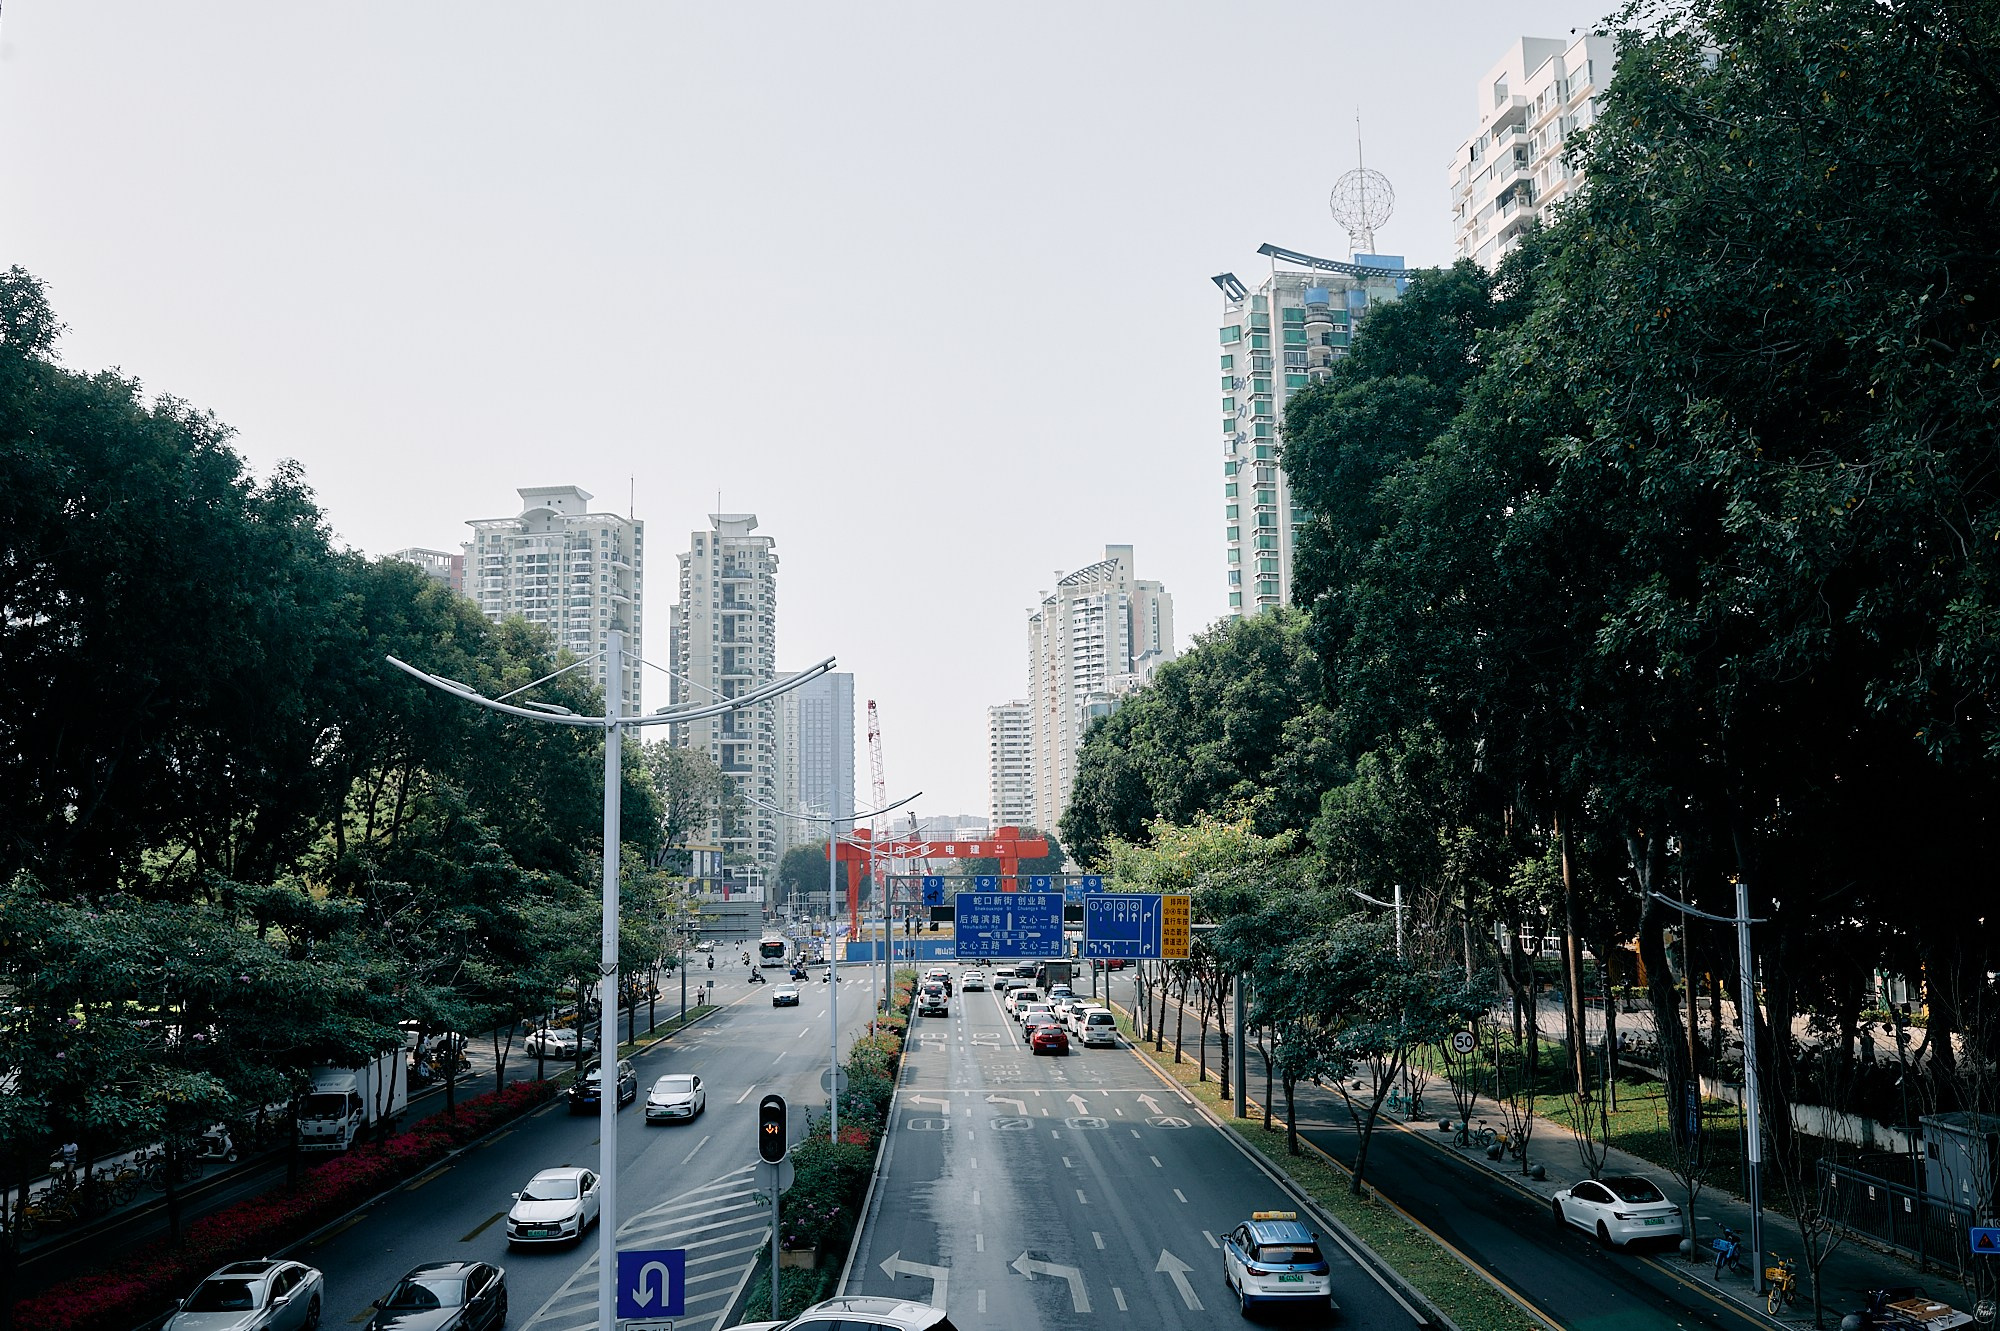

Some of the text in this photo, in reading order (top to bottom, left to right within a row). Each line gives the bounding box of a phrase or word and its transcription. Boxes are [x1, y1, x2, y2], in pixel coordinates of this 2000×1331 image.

[973, 896, 1046, 906] 蛇口新街 创业路
[959, 914, 1001, 924] 后海滨路
[1019, 914, 1060, 924] 文心一路
[993, 931, 1025, 939] 海德一道
[959, 941, 1000, 950] 文心五路
[1019, 941, 1060, 950] 文心二路
[1456, 1035, 1473, 1048] 50
